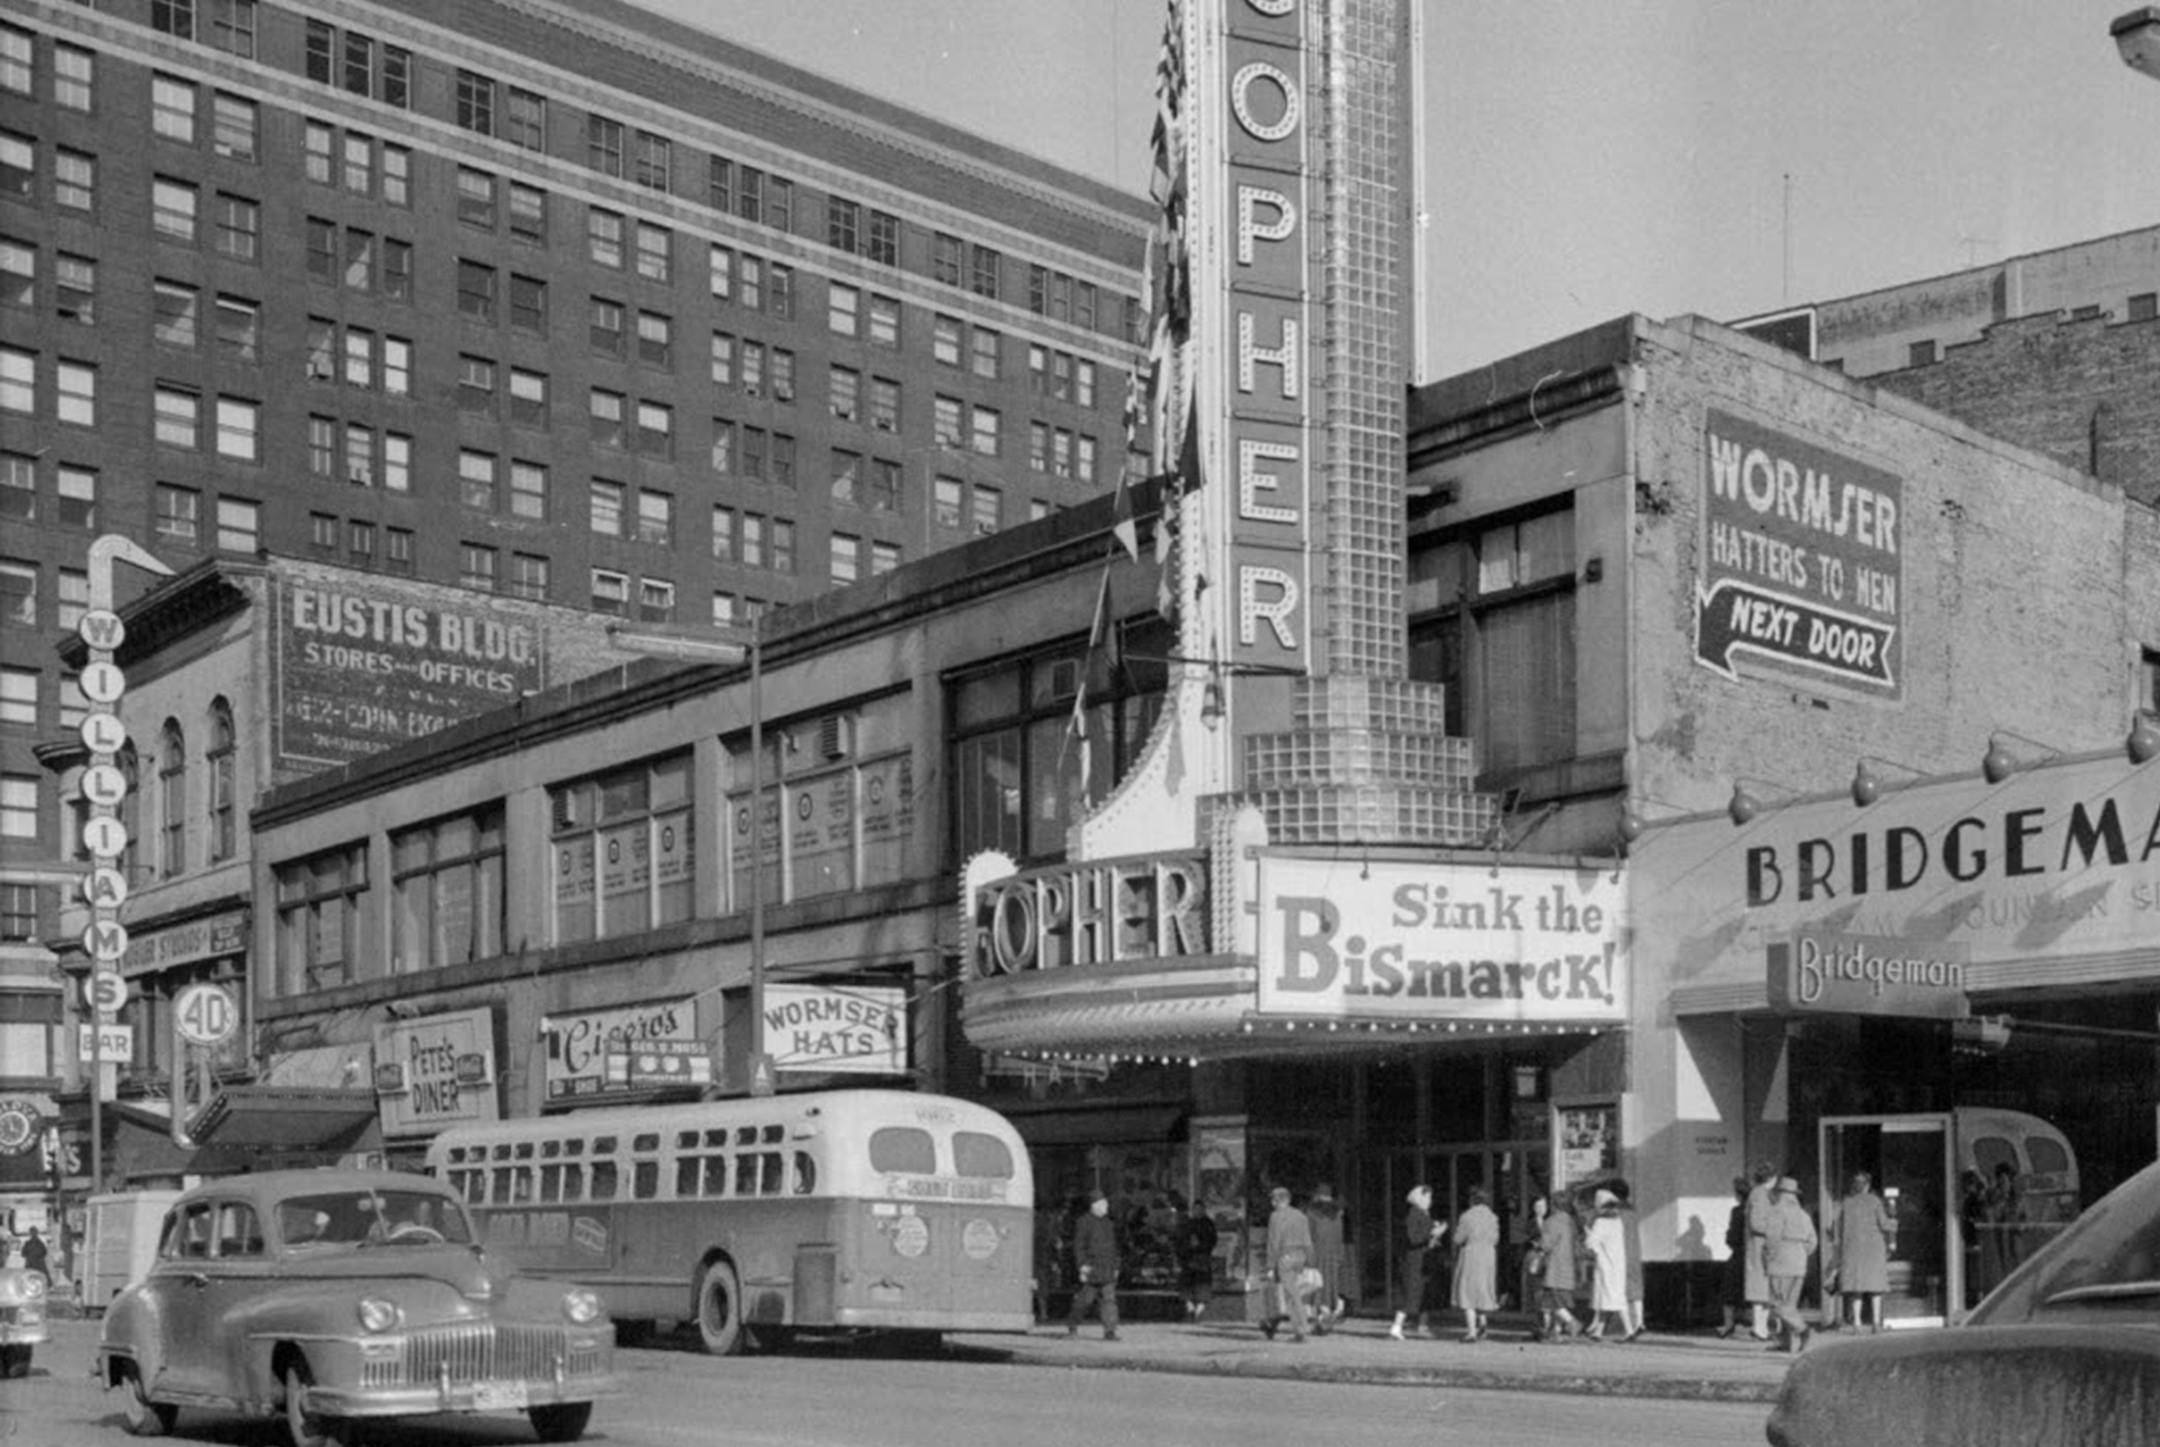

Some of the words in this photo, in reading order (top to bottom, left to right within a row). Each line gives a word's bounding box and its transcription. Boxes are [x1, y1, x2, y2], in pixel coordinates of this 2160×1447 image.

[1231, 0, 1299, 650] OPHER
[1710, 434, 1897, 553] WORMSER
[1712, 520, 1808, 588] HATTERS
[1818, 554, 1844, 600] TO
[1856, 566, 1896, 615] MEN
[294, 588, 428, 648] EUSTIS
[440, 612, 536, 666] BLDG.
[1730, 596, 1800, 647] NEXT
[1808, 617, 1876, 668] DOOR
[304, 642, 394, 673] STORES
[419, 660, 515, 692] OFFICES
[86, 617, 120, 1004] WILLIAMS
[976, 860, 1206, 978] GOPHER
[1392, 883, 1524, 932] Sink
[1535, 885, 1604, 935] the
[1802, 937, 1963, 1003] Bridgeman
[83, 1032, 128, 1053] BAR
[764, 996, 899, 1039] WORMSER
[793, 1030, 874, 1055] HATS
[410, 1034, 454, 1076] PETE'S
[412, 1079, 460, 1115] DINER
